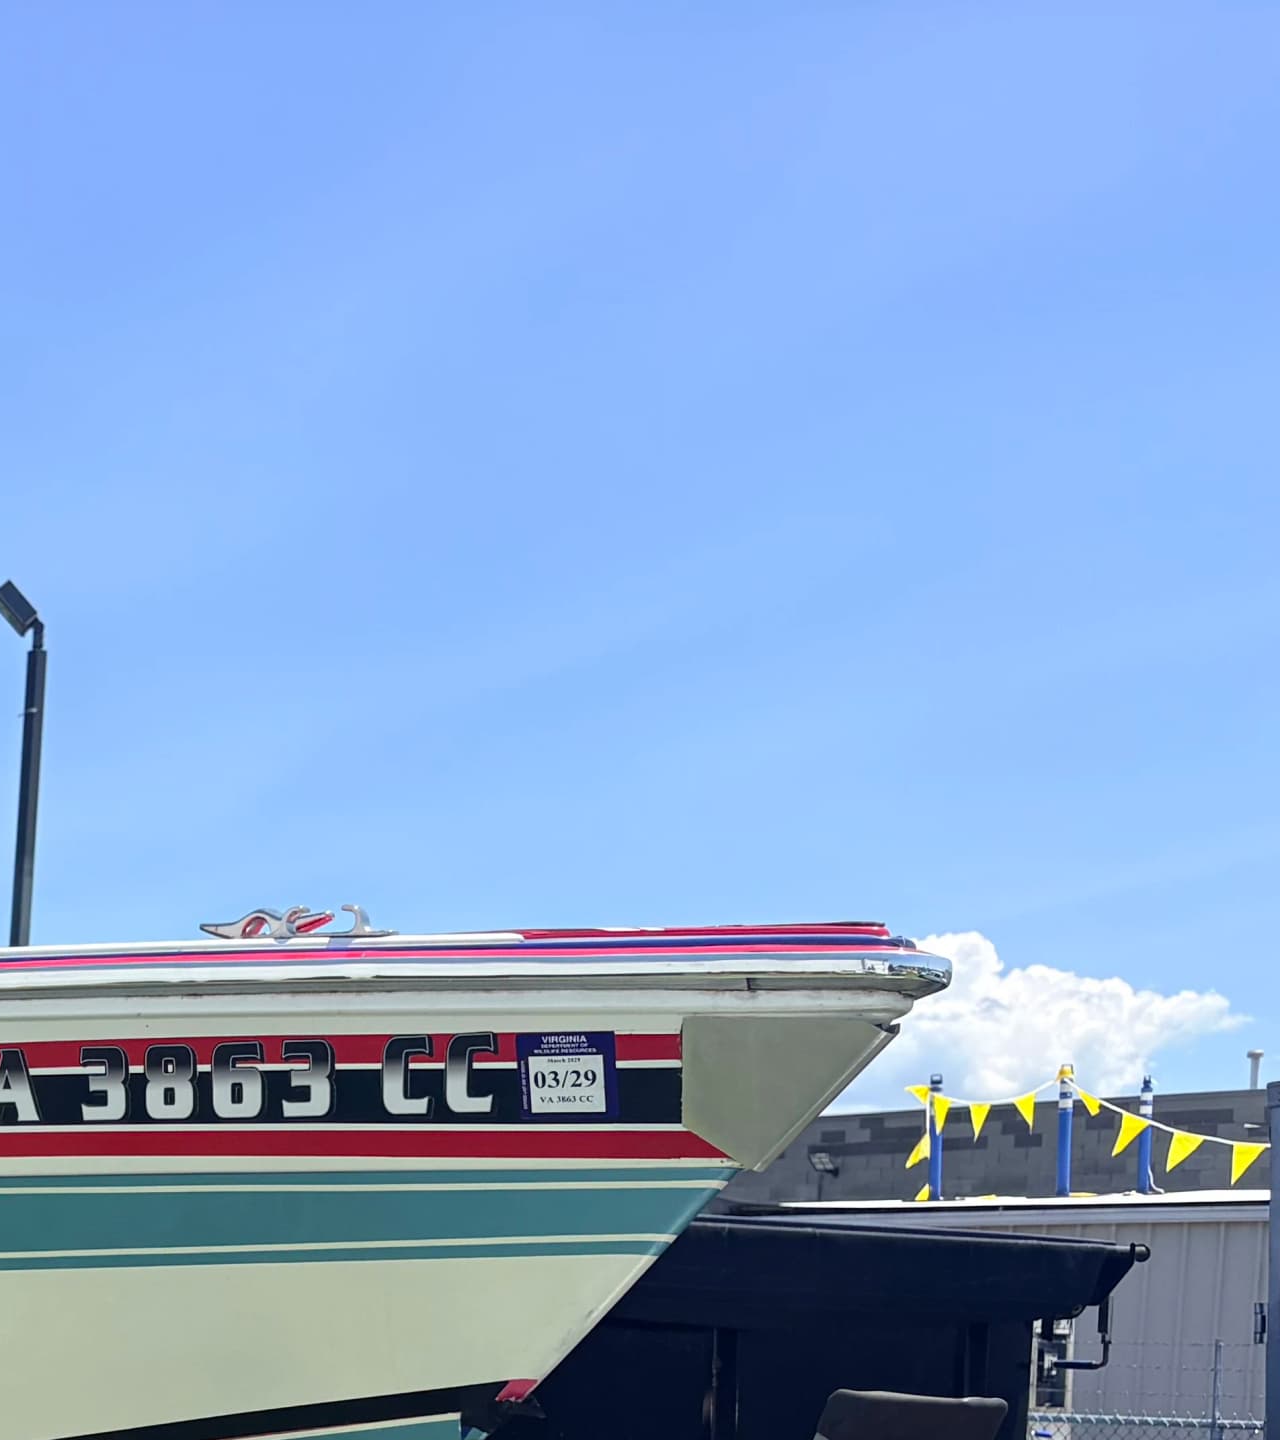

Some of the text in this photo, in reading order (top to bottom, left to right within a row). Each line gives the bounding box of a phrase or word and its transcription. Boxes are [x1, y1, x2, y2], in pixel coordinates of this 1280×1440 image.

[541, 1035, 587, 1044] VIRGINIA
[79, 1039, 335, 1121] 3863
[382, 1031, 499, 1116] CC
[533, 1069, 597, 1089] 03/29
